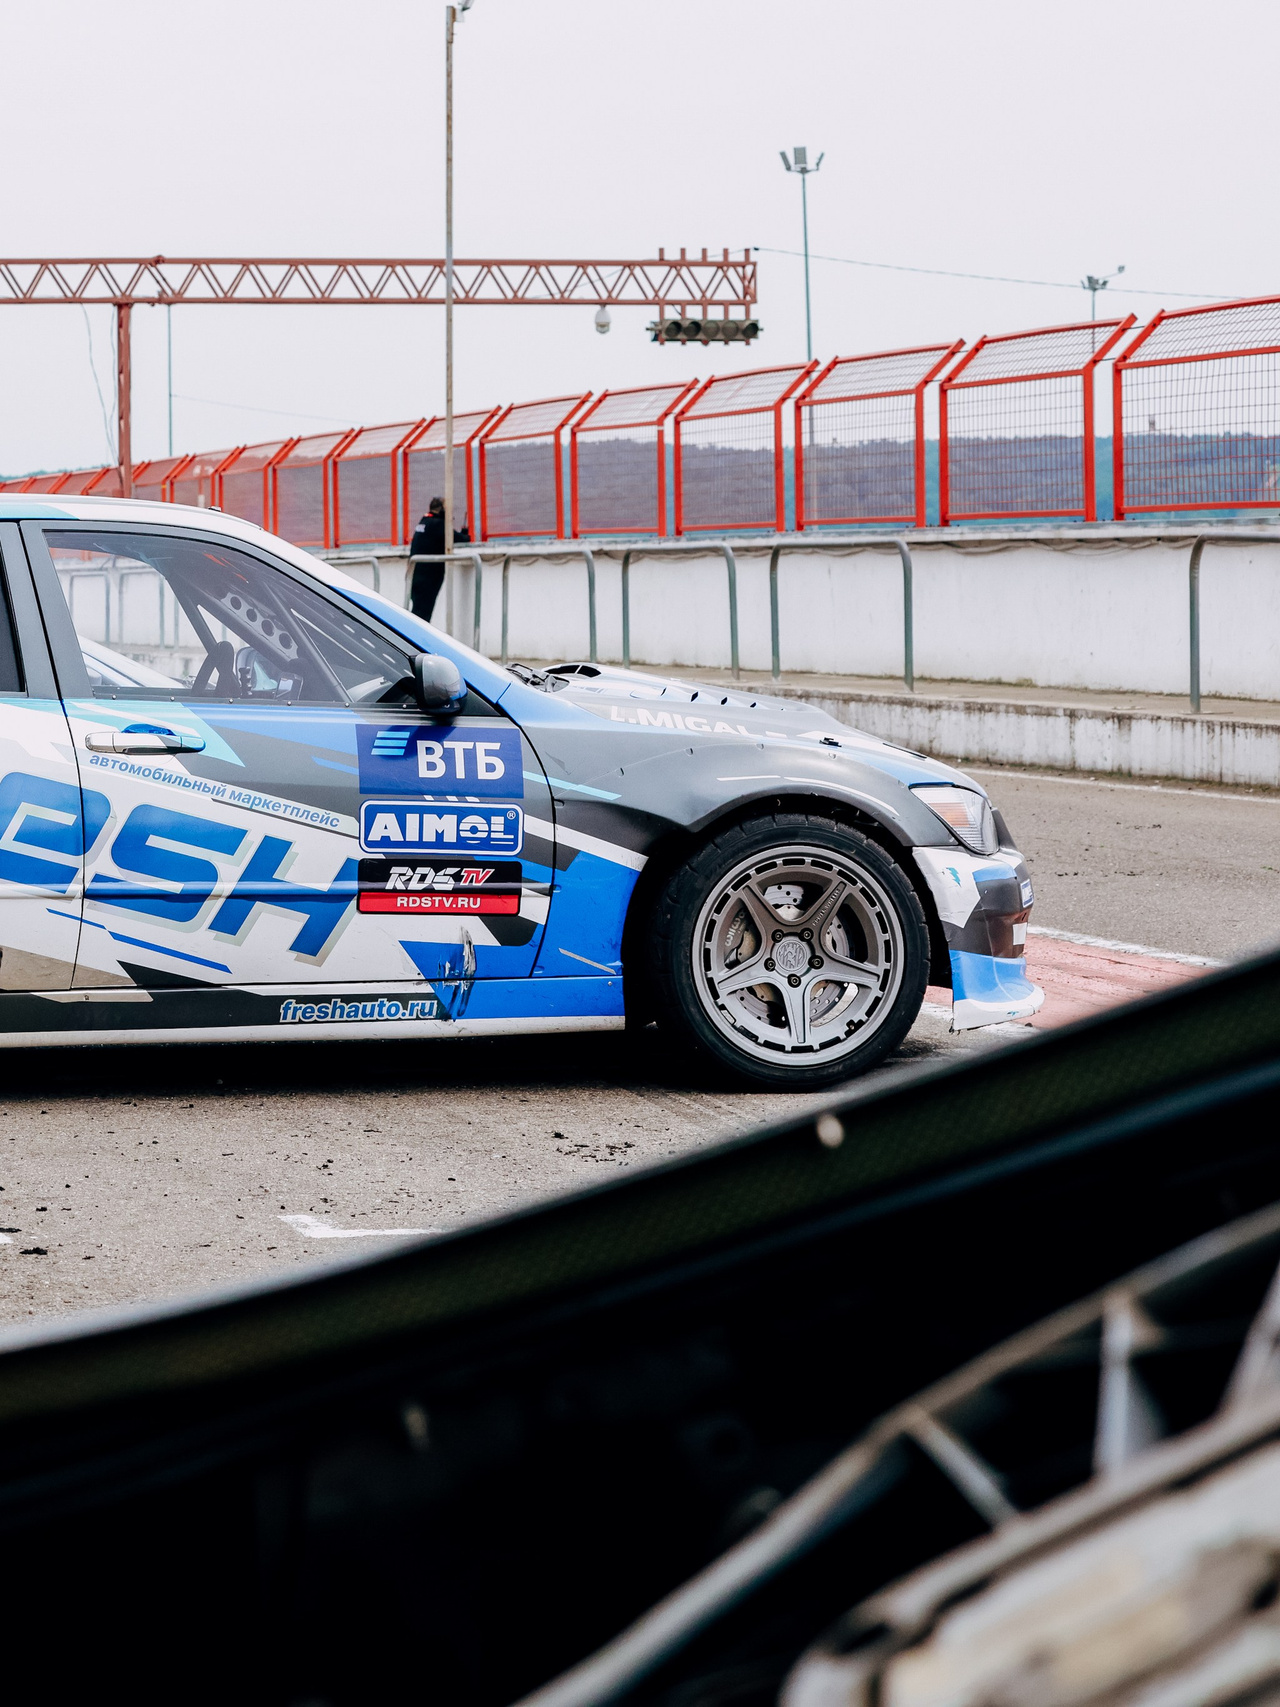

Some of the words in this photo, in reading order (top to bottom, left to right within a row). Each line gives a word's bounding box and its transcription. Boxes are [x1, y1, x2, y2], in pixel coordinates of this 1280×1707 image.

[417, 740, 505, 780] ВТБ
[89, 753, 227, 798] автомобильный
[228, 789, 341, 828] маркетплейс
[367, 813, 514, 845] AIMOL
[397, 896, 481, 908] RDSTV.RU
[280, 998, 437, 1023] freshauto.ru
